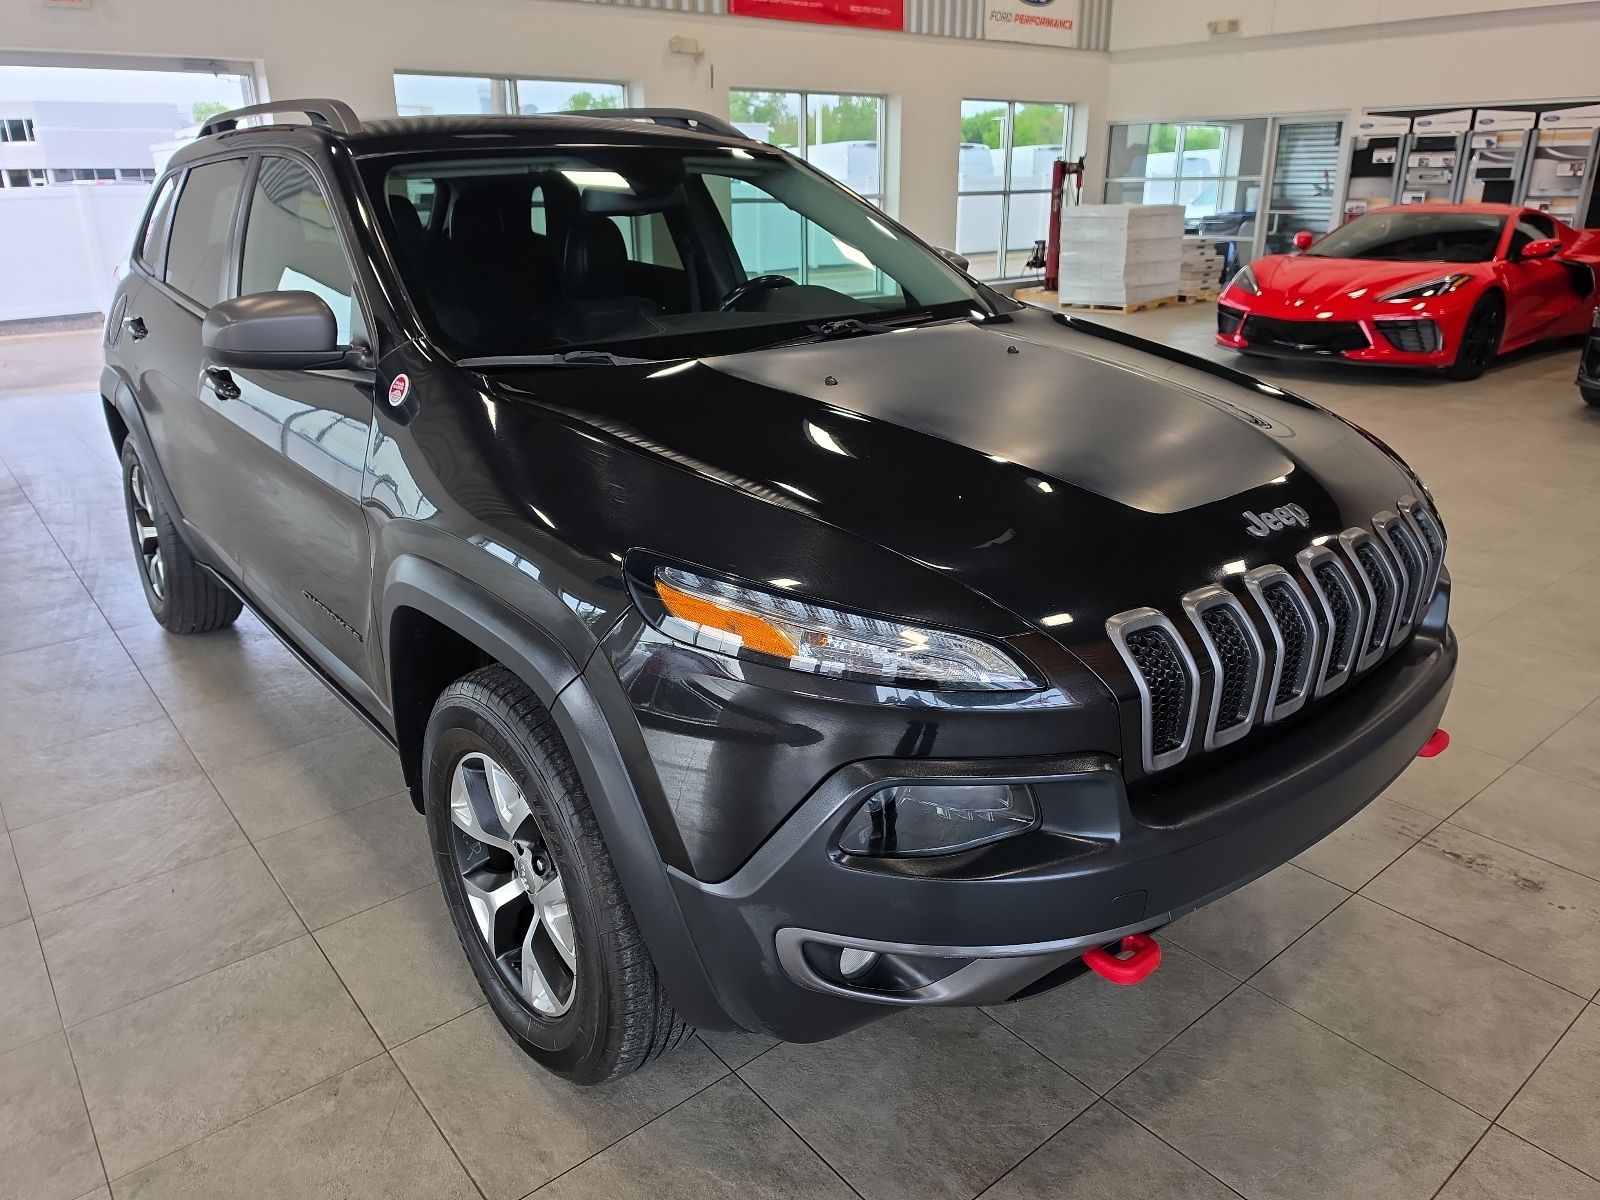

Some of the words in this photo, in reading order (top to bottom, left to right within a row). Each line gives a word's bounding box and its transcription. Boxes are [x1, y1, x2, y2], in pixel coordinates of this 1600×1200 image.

[989, 10, 1014, 23] FORD
[1014, 13, 1073, 30] PERFORMANCE
[1241, 502, 1309, 538] Jeep
